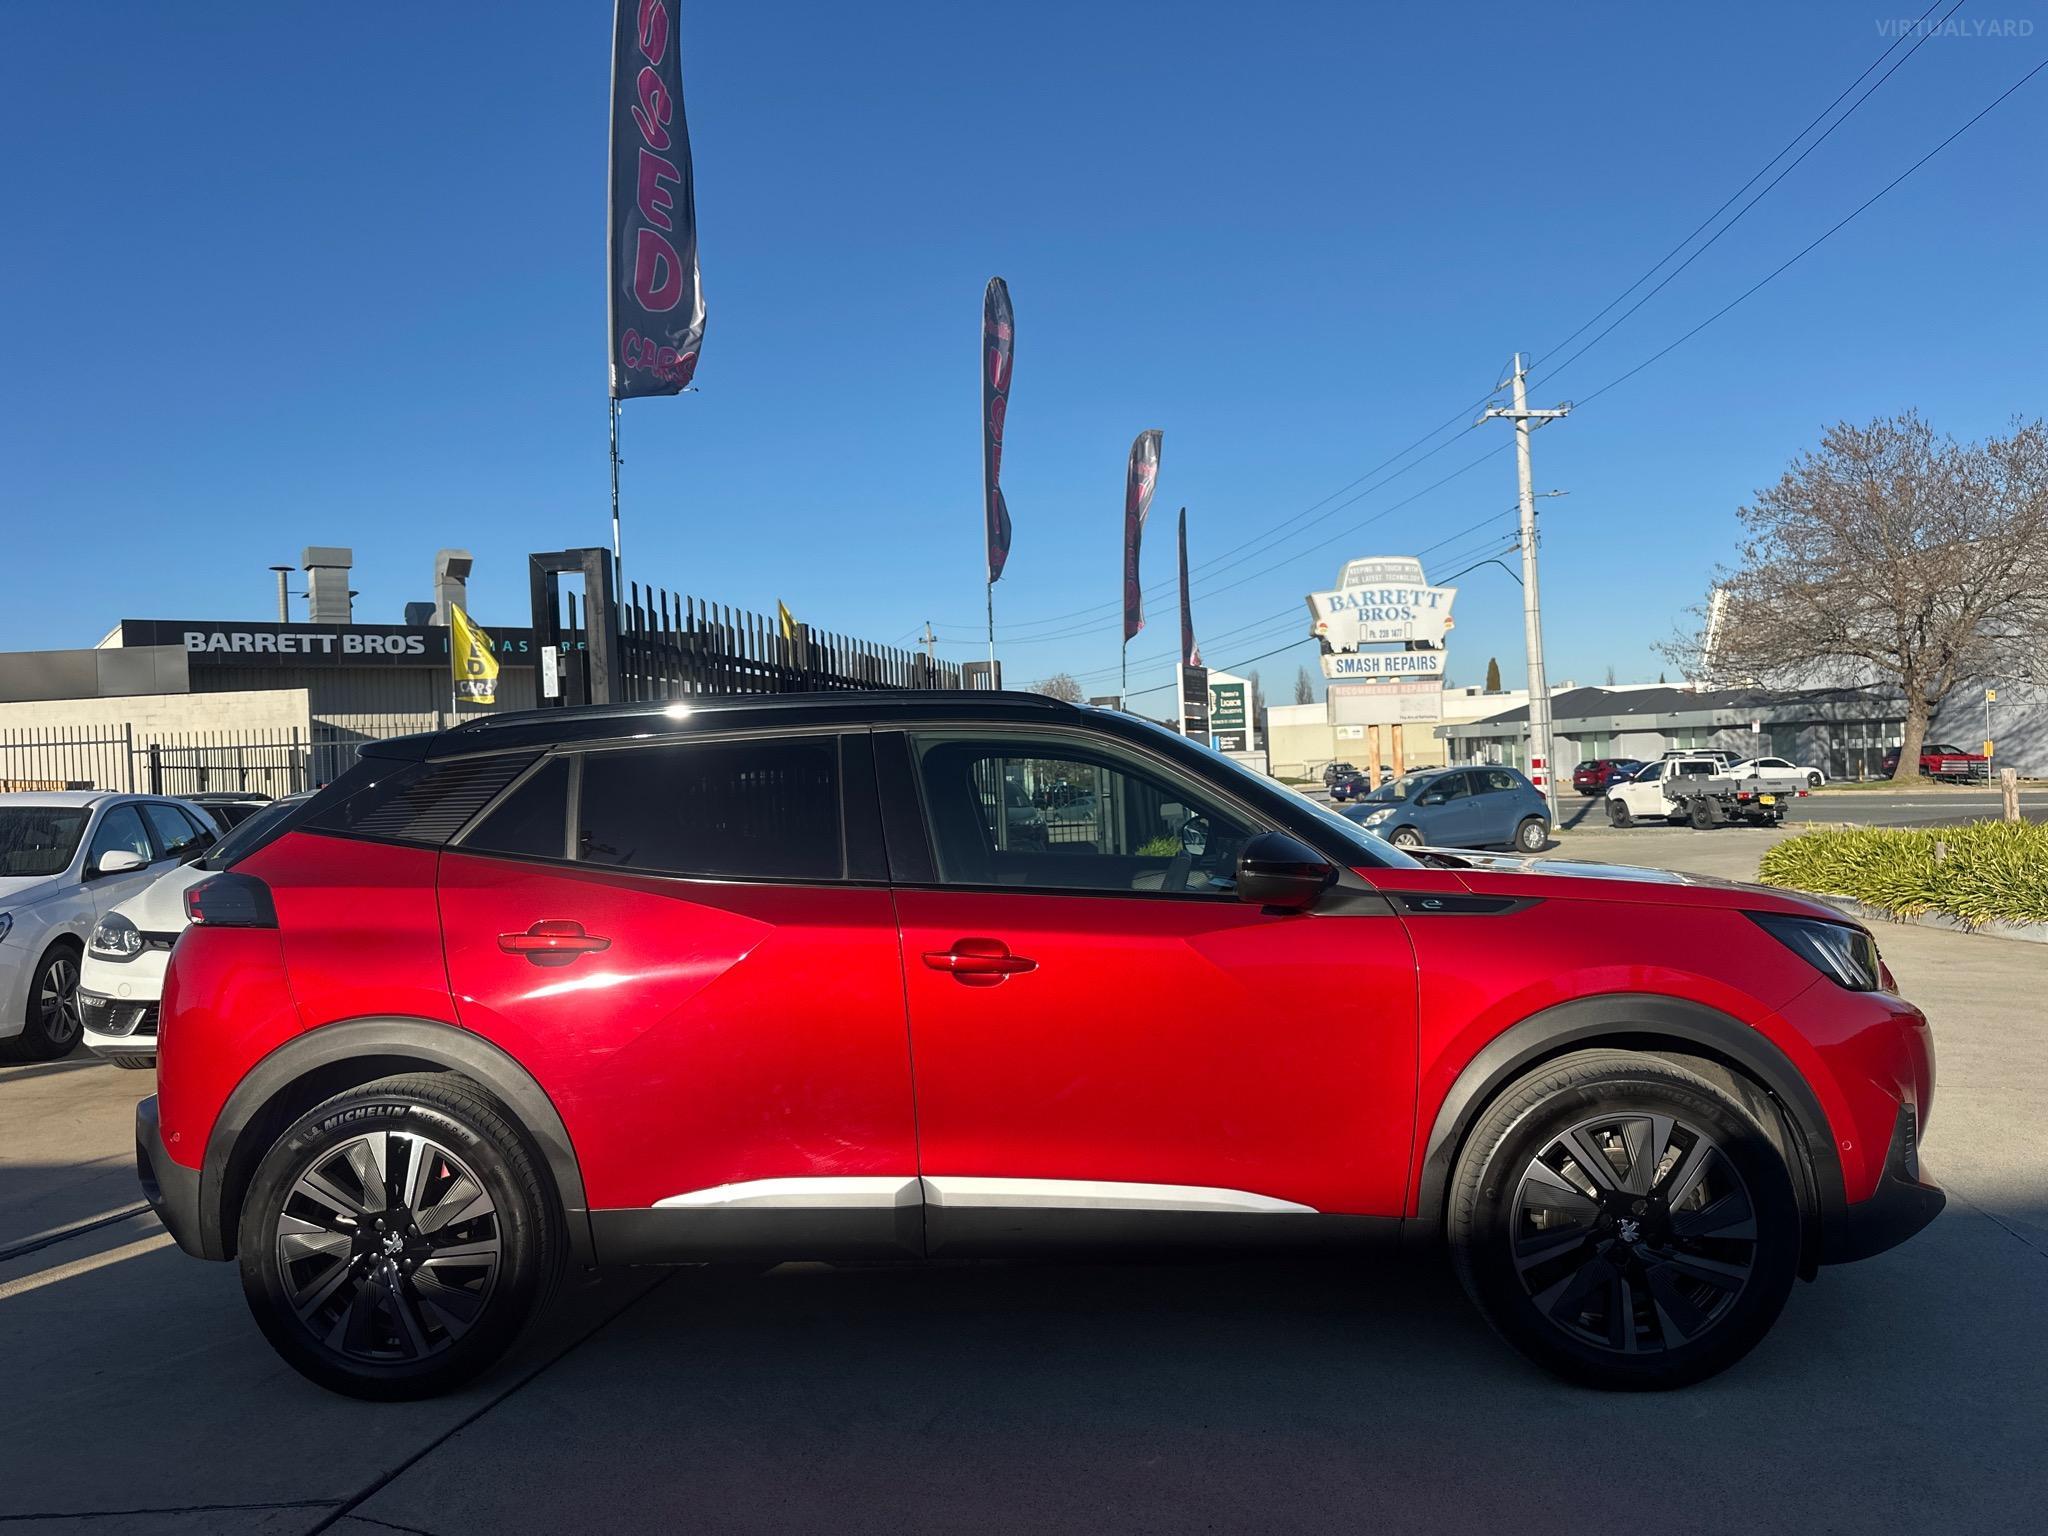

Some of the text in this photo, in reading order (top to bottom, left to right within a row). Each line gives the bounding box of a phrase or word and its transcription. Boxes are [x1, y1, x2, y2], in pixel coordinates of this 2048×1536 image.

[1328, 589, 1443, 612] BARRETT
[1358, 606, 1417, 622] BROS.
[184, 632, 425, 654] BARRETT BROS
[1336, 656, 1437, 673] SMASH REPAIRS
[459, 680, 494, 696] CARS
[324, 1106, 405, 1130] MICHELIN
